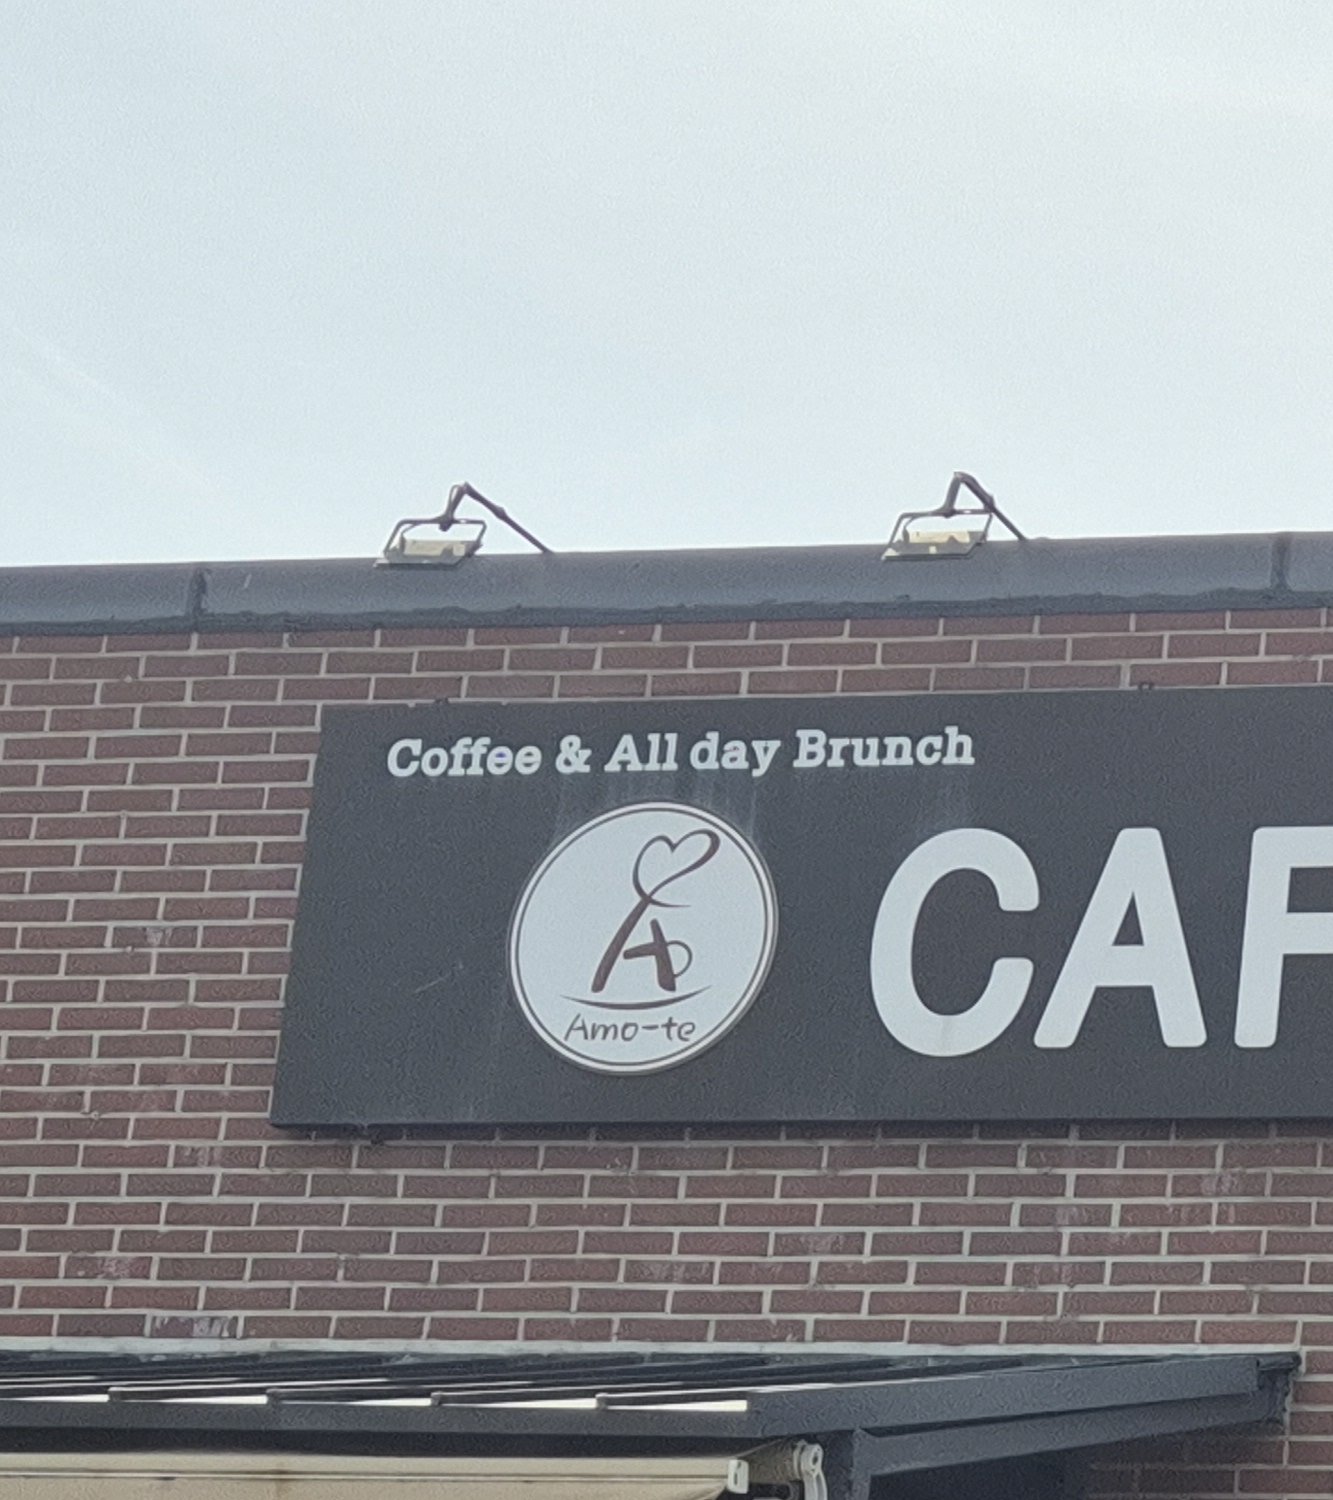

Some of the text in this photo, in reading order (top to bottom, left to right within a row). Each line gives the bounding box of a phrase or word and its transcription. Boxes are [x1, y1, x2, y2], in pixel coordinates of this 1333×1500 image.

[387, 725, 976, 777] Coffee & All day Brunch
[563, 1012, 696, 1043] Amo-te
